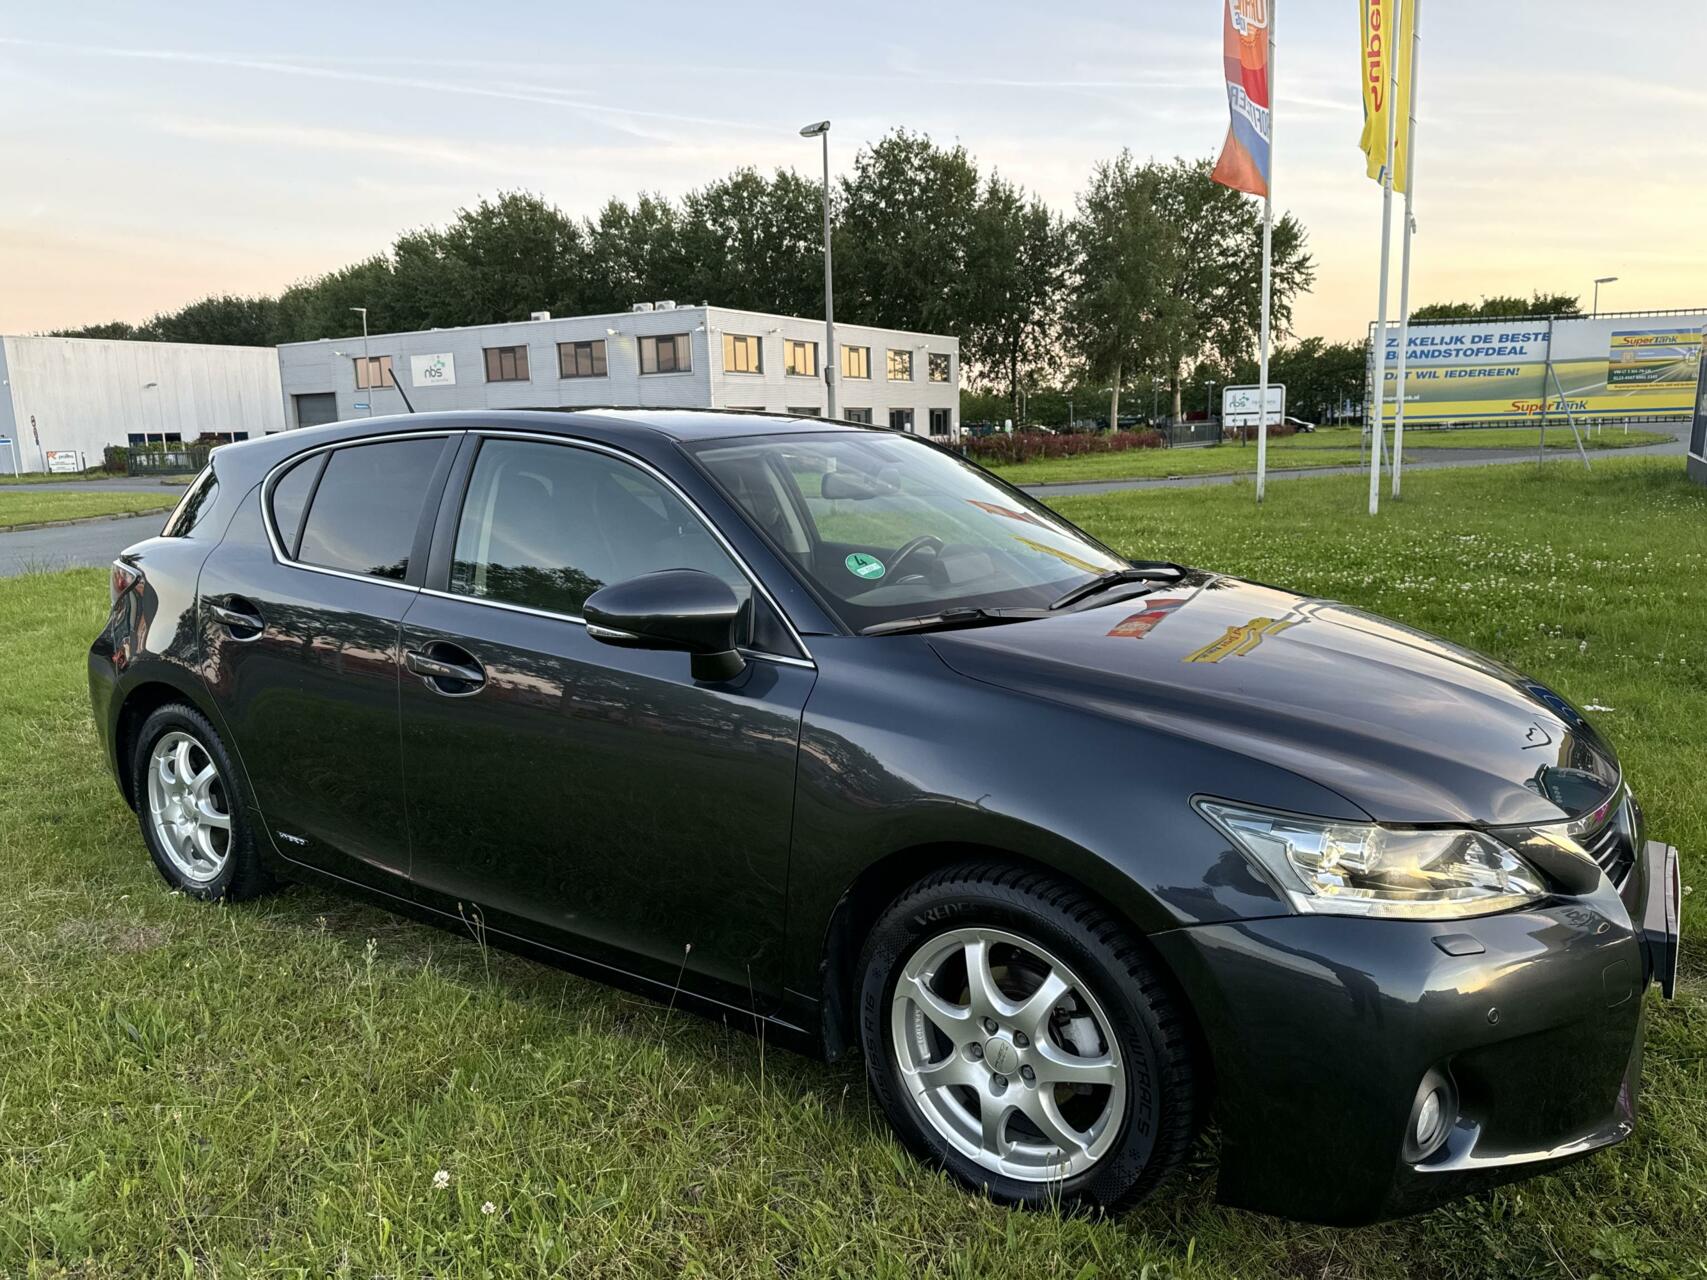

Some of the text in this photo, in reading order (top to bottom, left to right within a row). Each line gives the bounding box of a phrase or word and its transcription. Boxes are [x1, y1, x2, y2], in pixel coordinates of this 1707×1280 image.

[1385, 332, 1550, 348] ZKELIJK DE BESTE
[424, 365, 443, 379] nbs
[1415, 370, 1439, 379] WIL
[1444, 367, 1520, 379] IEDEREEN!
[854, 555, 868, 566] 4
